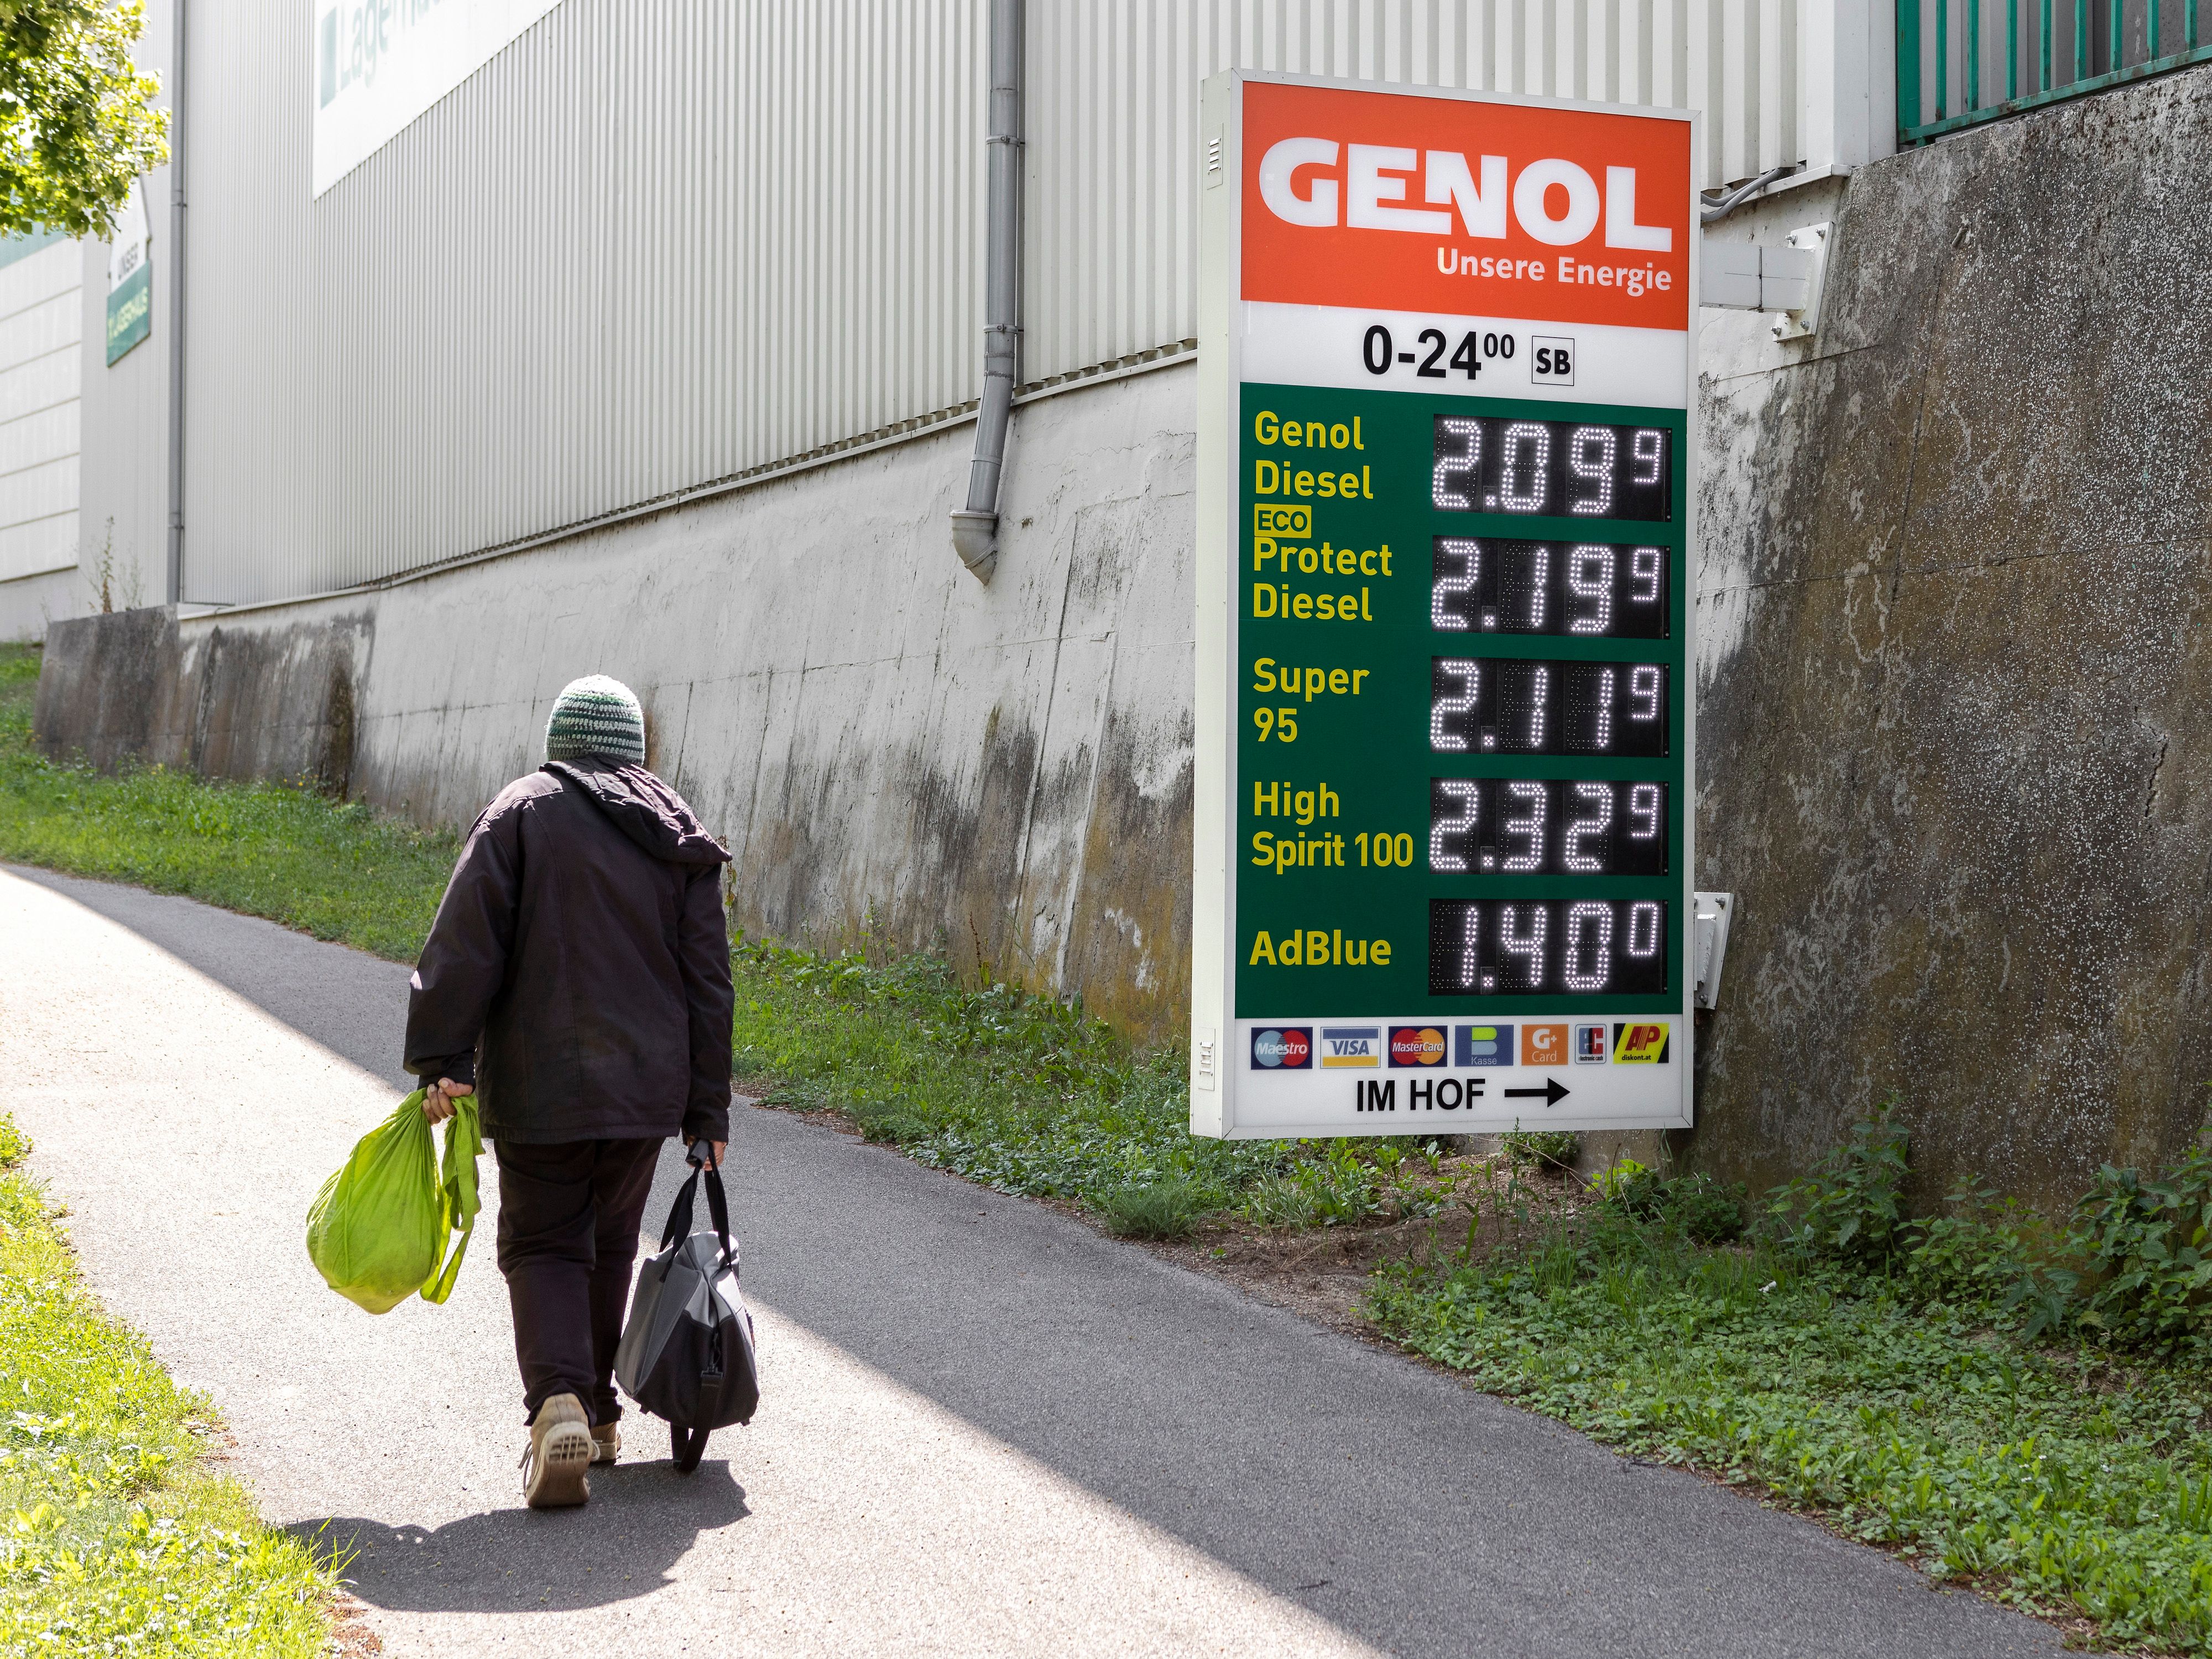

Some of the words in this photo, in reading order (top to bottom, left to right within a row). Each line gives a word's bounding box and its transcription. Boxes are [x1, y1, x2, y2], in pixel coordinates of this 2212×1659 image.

[1259, 137, 1672, 252] GENOL
[1437, 247, 1545, 281] Unsere
[1558, 257, 1672, 297] Energie
[1536, 348, 1572, 374] SB
[1255, 410, 1364, 450] Genol
[1255, 460, 1374, 500] Diesel
[1258, 510, 1308, 532] ECO
[1254, 537, 1392, 576] Protect
[1254, 583, 1373, 621] Diesel
[1253, 658, 1370, 702] Super
[1254, 707, 1297, 743] 95
[1254, 781, 1339, 825] High
[1251, 831, 1345, 875] Spirit
[1355, 832, 1413, 867] 100
[1249, 930, 1391, 966] AdBlue
[1256, 1042, 1308, 1055] Maestro
[1329, 1040, 1370, 1055] VISA
[1392, 1041, 1444, 1053] MasterCard
[1532, 1050, 1557, 1062] Card
[1625, 1026, 1661, 1051] AP
[1471, 1057, 1497, 1066] Kasse
[1357, 1079, 1396, 1112] IM
[1410, 1078, 1486, 1111] HOF
